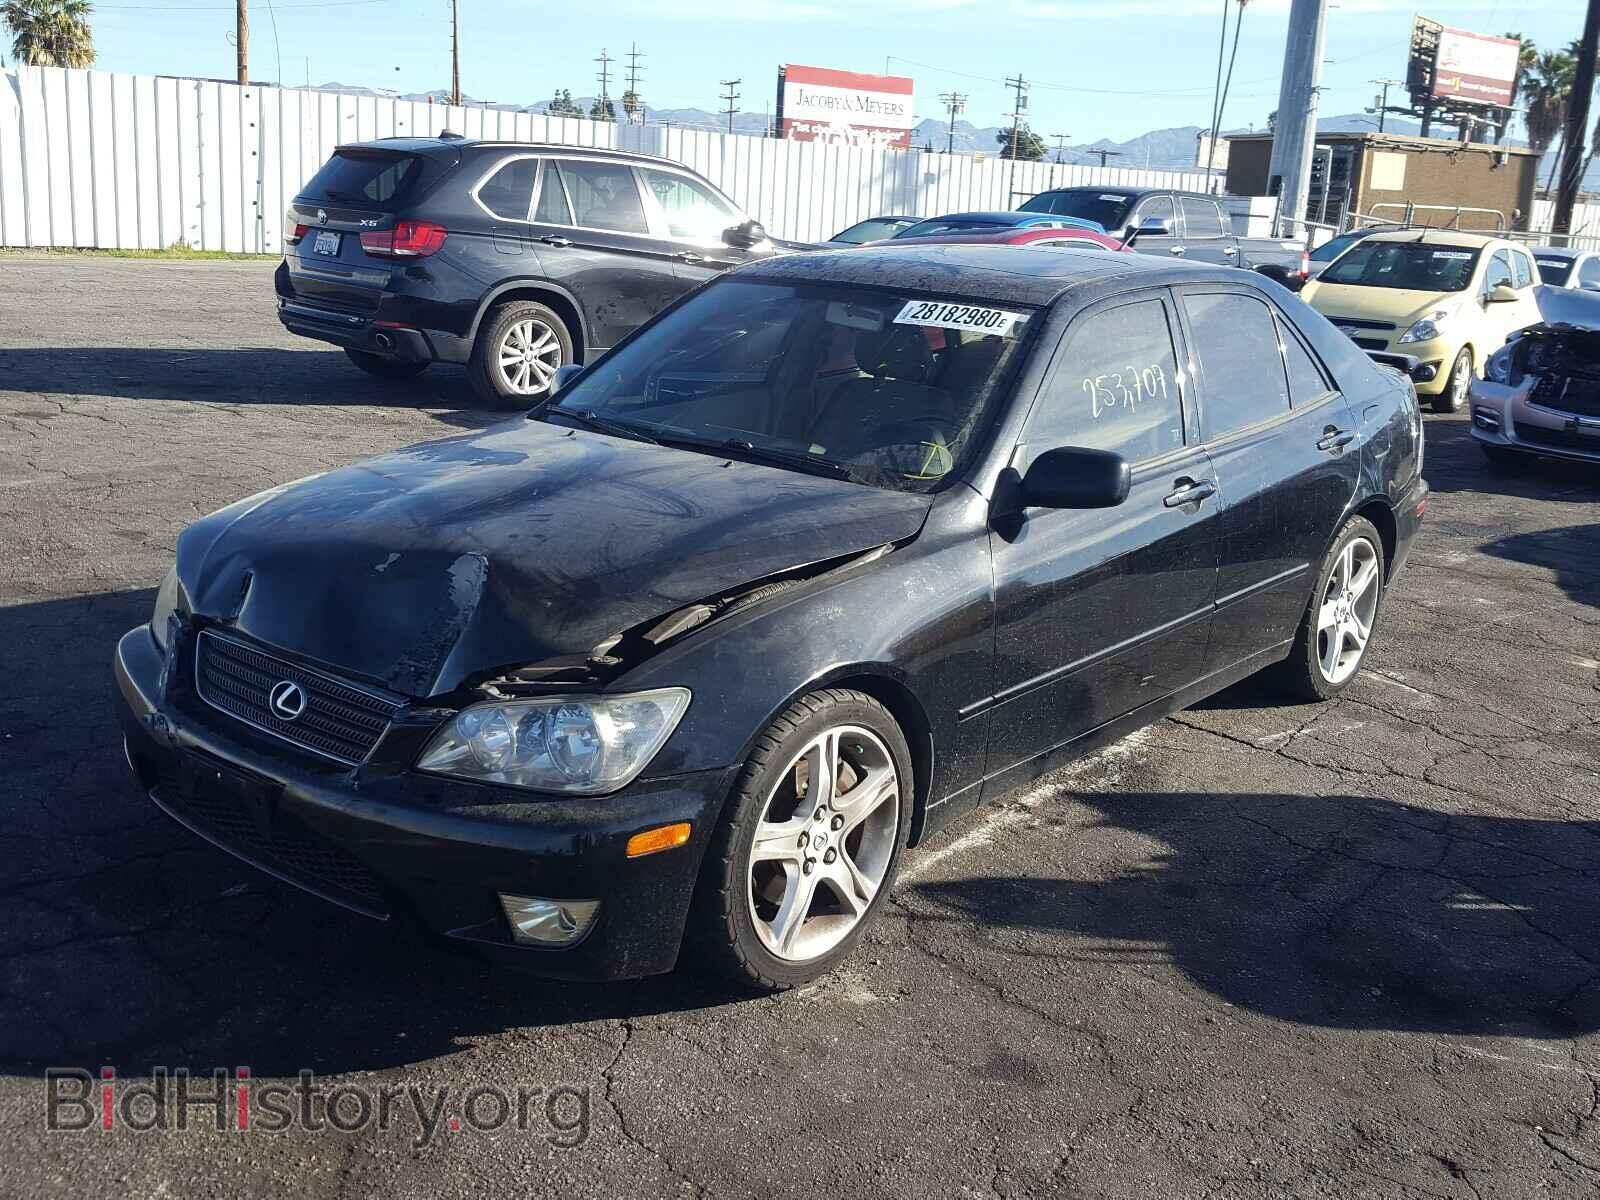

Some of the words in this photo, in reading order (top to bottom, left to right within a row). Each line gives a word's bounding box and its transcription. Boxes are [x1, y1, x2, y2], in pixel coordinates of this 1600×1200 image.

[796, 88, 842, 109] JACOBY
[855, 95, 905, 116] MEYERS
[360, 219, 377, 227] X5
